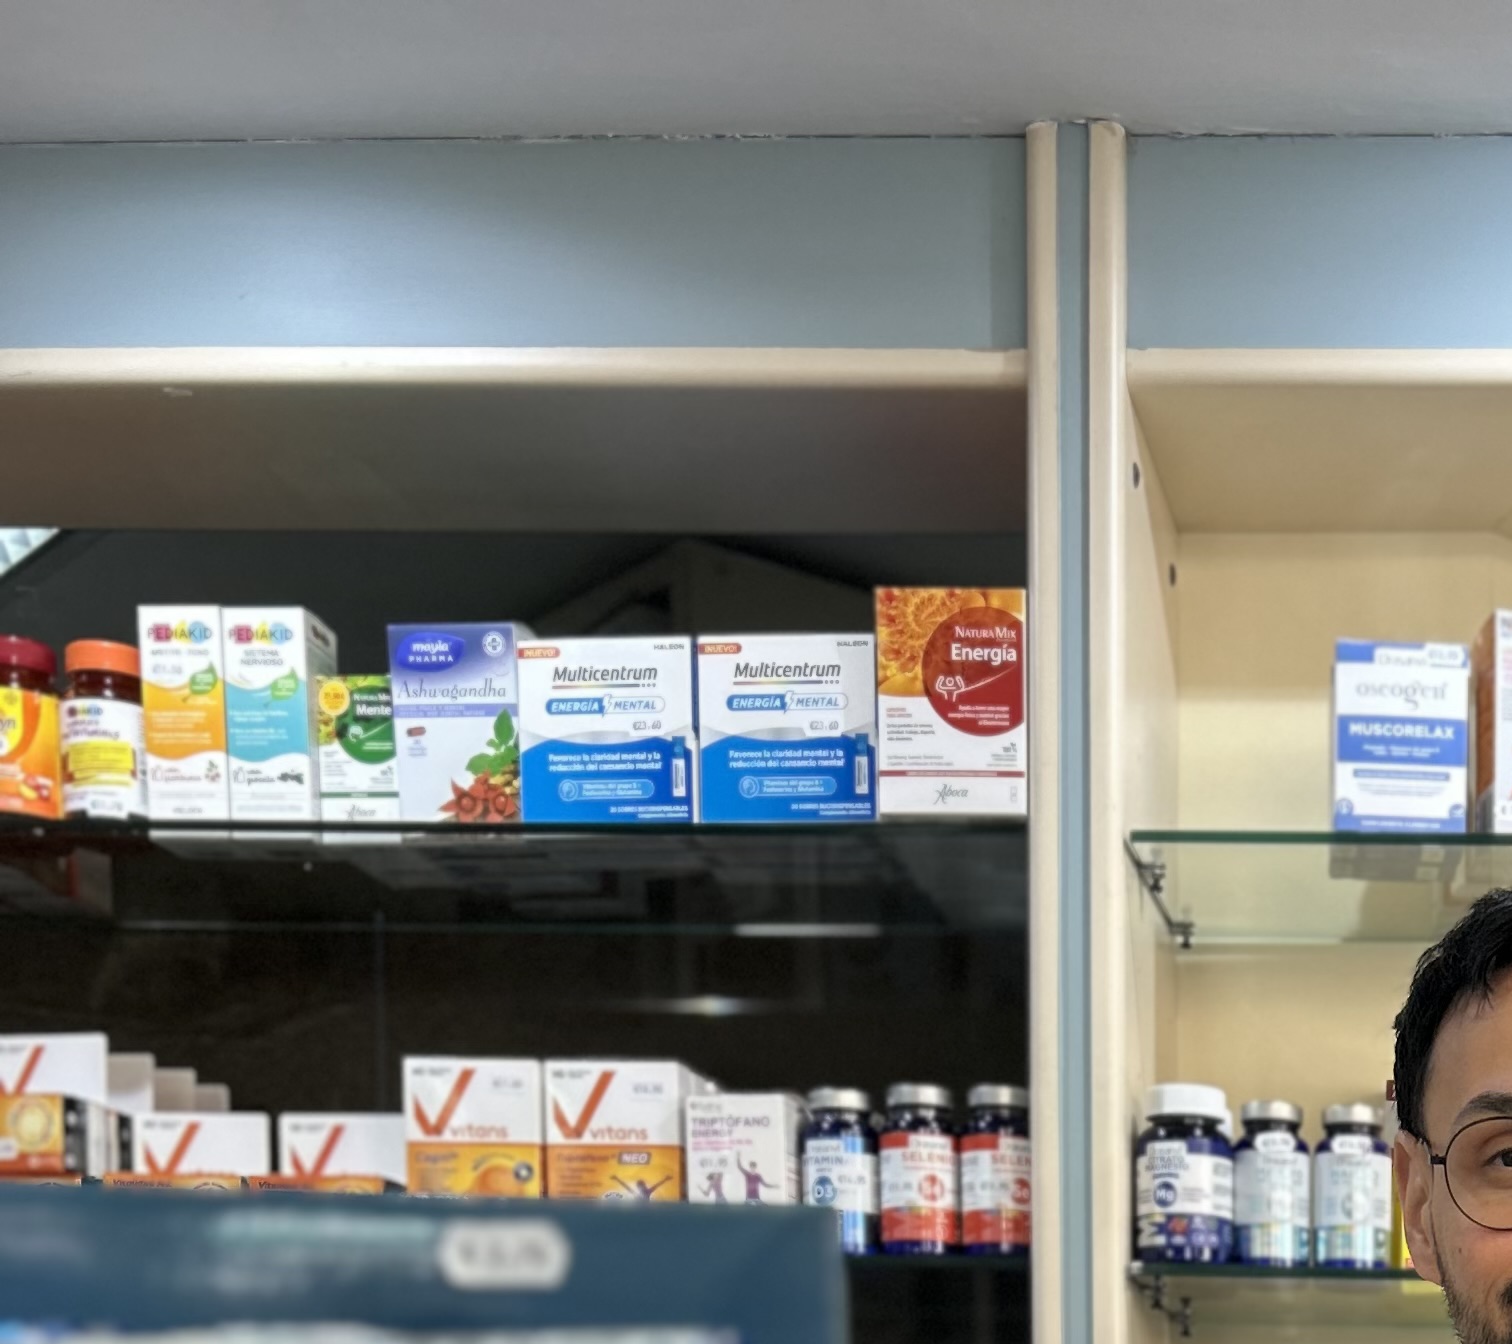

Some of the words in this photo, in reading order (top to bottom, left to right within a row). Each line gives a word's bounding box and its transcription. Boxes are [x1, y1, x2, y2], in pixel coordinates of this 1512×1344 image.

[148, 625, 212, 640] PEDIAKID
[228, 627, 293, 641] PEDIAKID
[408, 654, 453, 663] PHARMA
[951, 643, 1017, 665] Energía
[240, 658, 283, 666] NERVIOSO
[552, 665, 657, 682] Multicentrum
[734, 661, 841, 678] Multicentrum
[397, 677, 507, 701] Ashwagandha
[551, 698, 600, 712] ENERGÍA
[613, 700, 657, 710] MENTAL
[732, 696, 781, 709] ENERGÍA
[795, 696, 840, 707] MENTAL
[356, 703, 392, 717] Mente
[1348, 721, 1455, 740] MUSCORELAX
[620, 1152, 649, 1164] NEO
[991, 1152, 1032, 1165] SELEN
[1156, 1188, 1175, 1202] Mg
